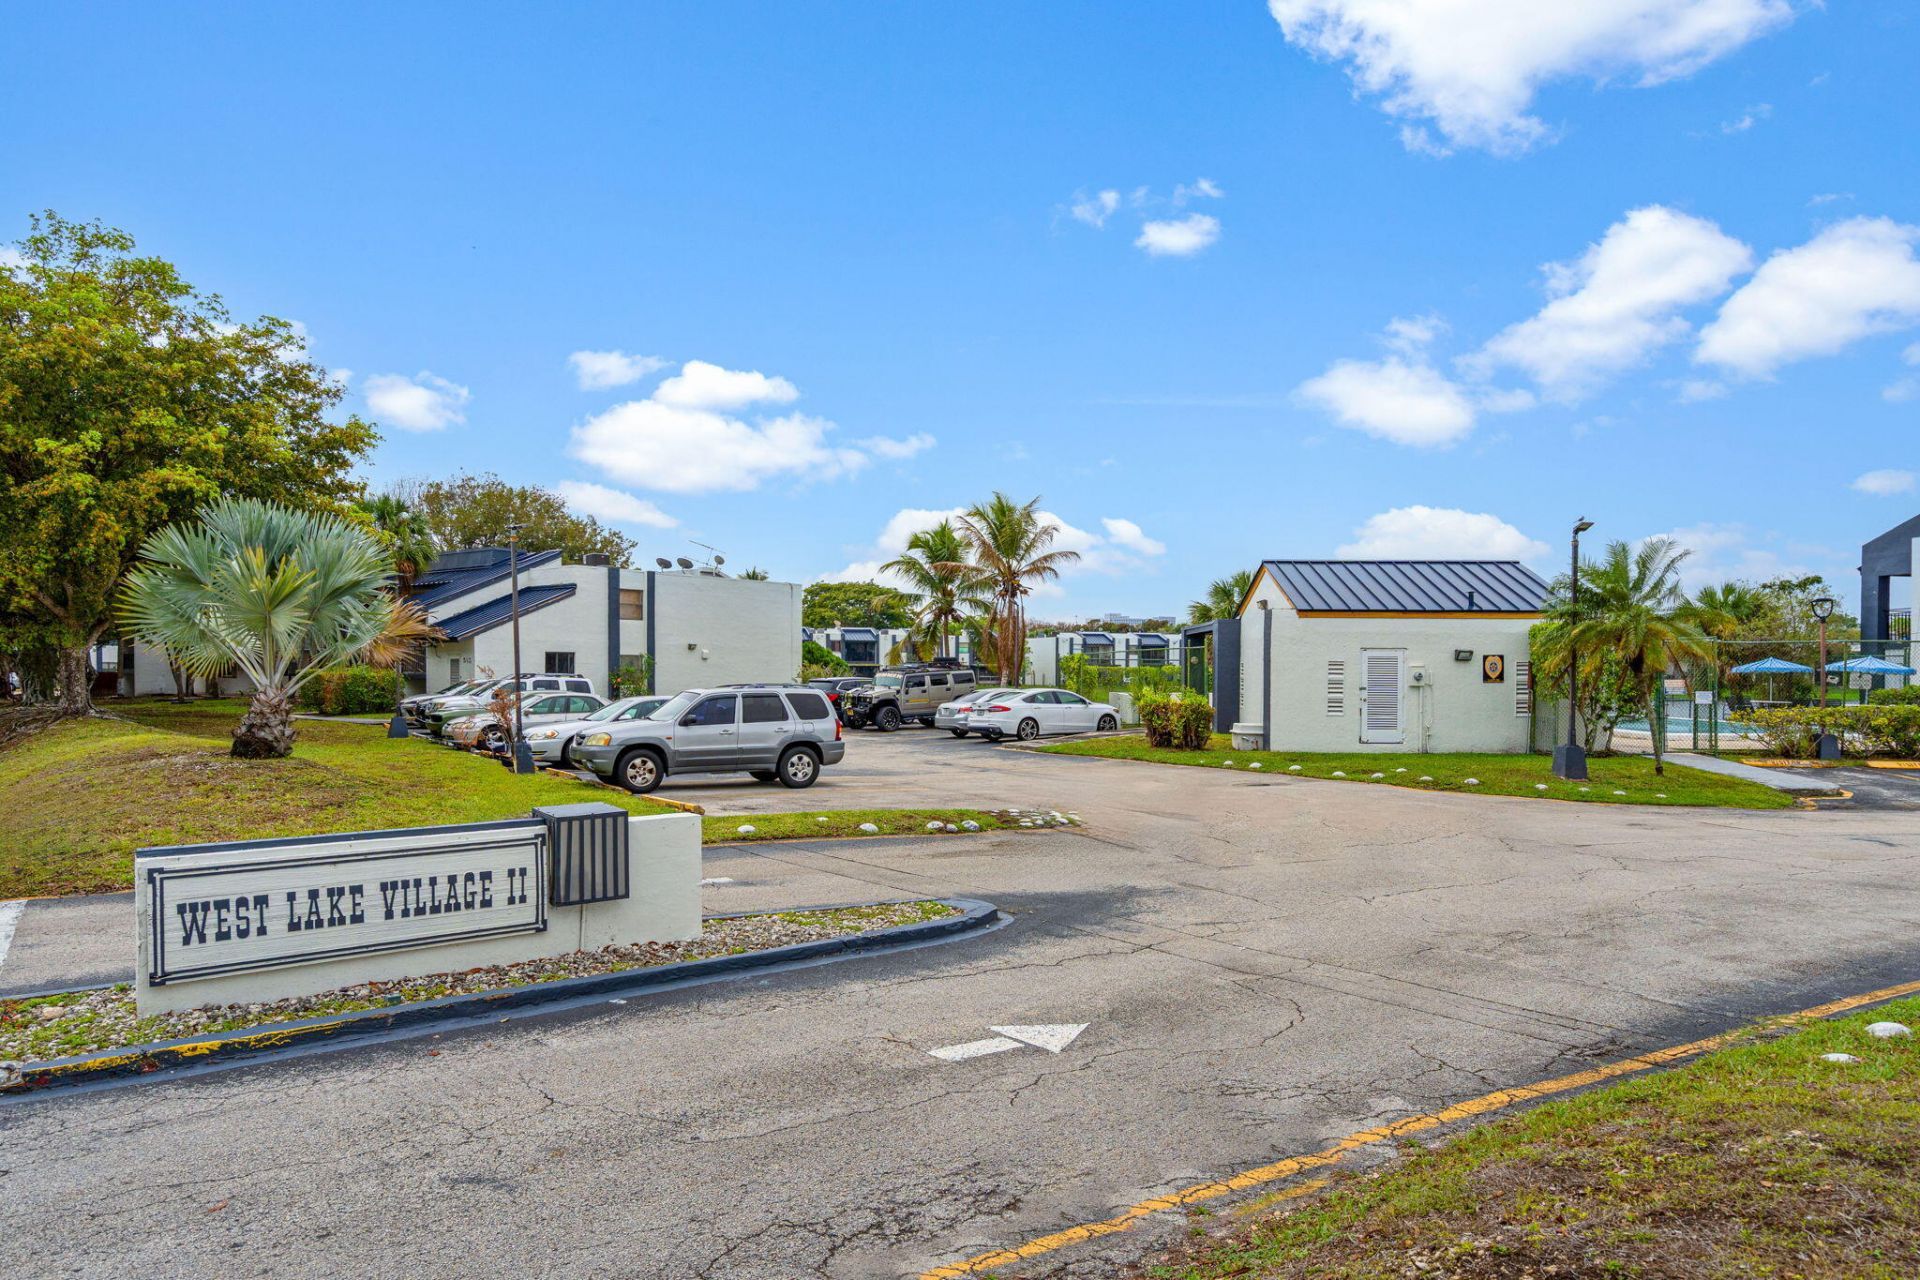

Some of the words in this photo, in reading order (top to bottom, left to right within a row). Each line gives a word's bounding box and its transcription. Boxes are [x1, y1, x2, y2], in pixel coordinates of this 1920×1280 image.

[176, 894, 270, 947] WEST
[286, 884, 365, 933] LAKE
[380, 871, 493, 921] VILLAGE
[507, 866, 528, 906] II
